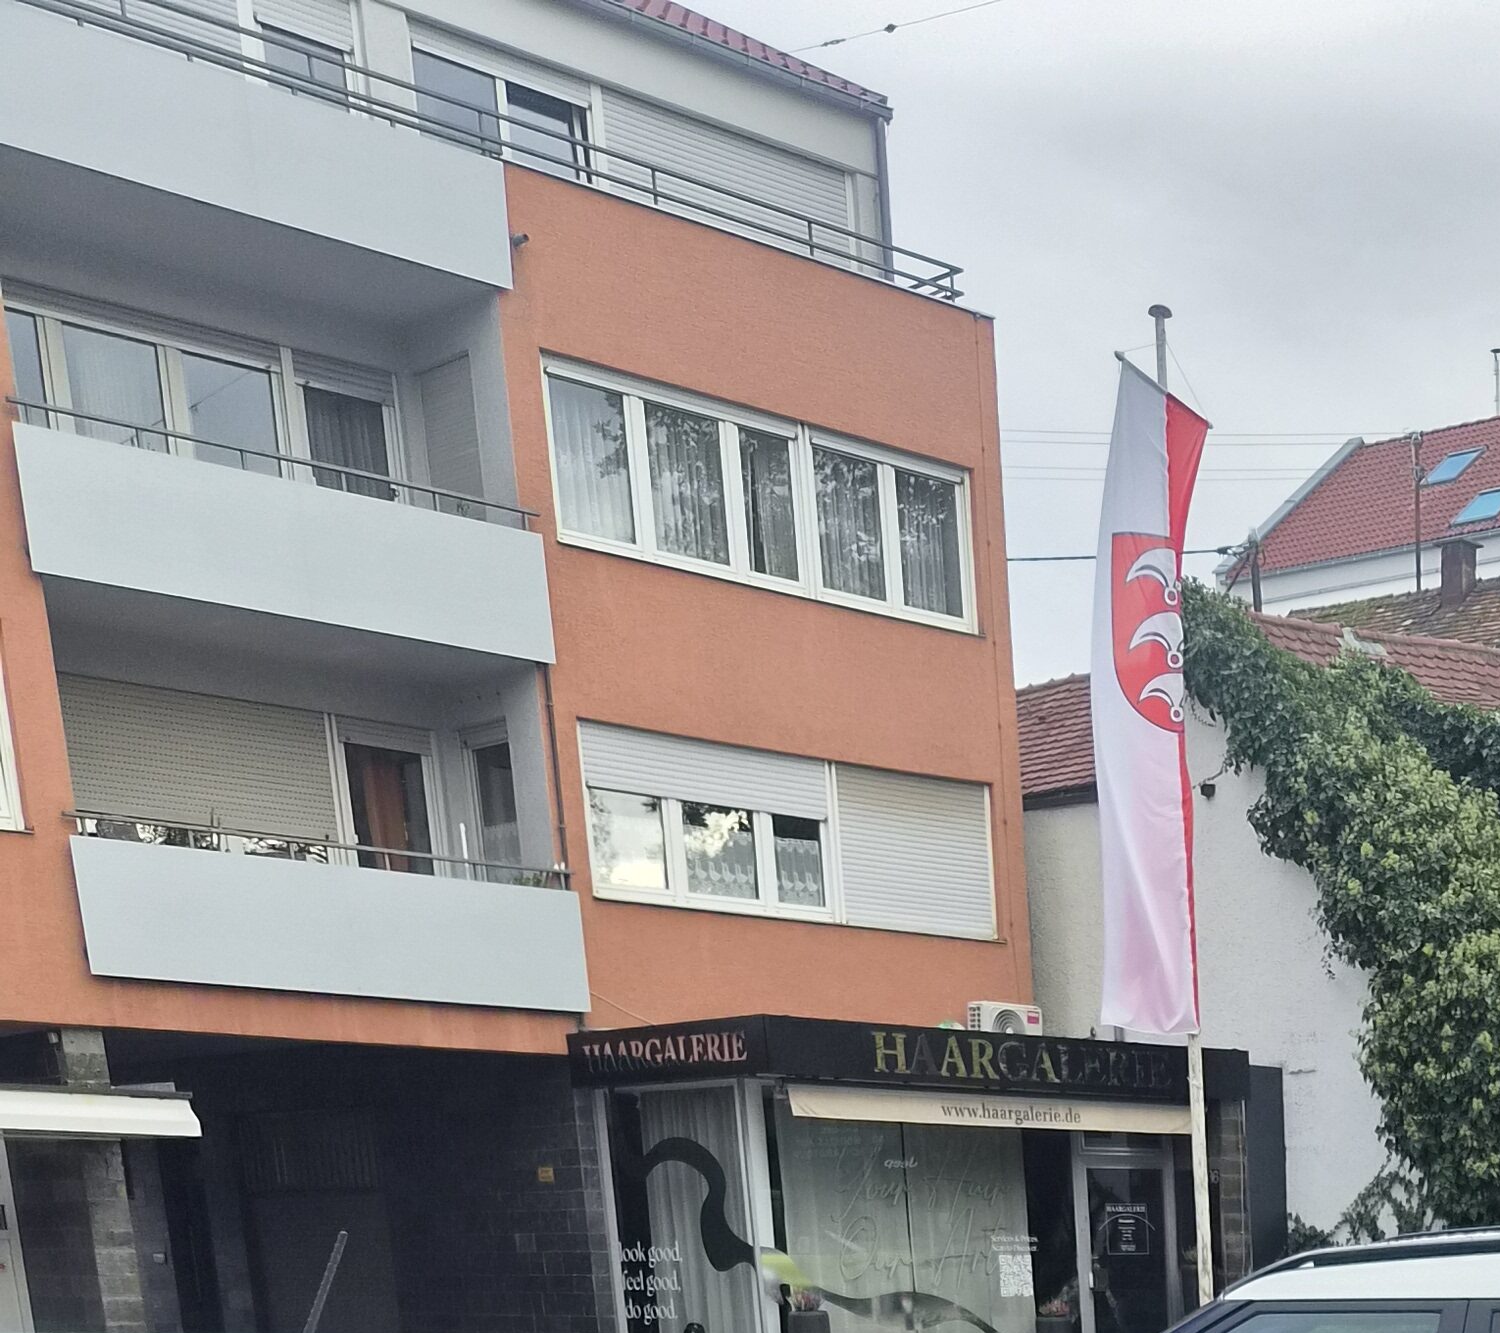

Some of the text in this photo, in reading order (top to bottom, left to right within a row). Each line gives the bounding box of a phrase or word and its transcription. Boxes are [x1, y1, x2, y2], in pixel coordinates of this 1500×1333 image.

[582, 1030, 747, 1073] HAARGALERIE
[871, 1031, 1175, 1088] HAARGALERIE
[941, 1103, 1081, 1125] www.haargalerie.de
[619, 1240, 683, 1268] look good,
[622, 1269, 681, 1297] feel good,
[626, 1298, 678, 1325] do good.
